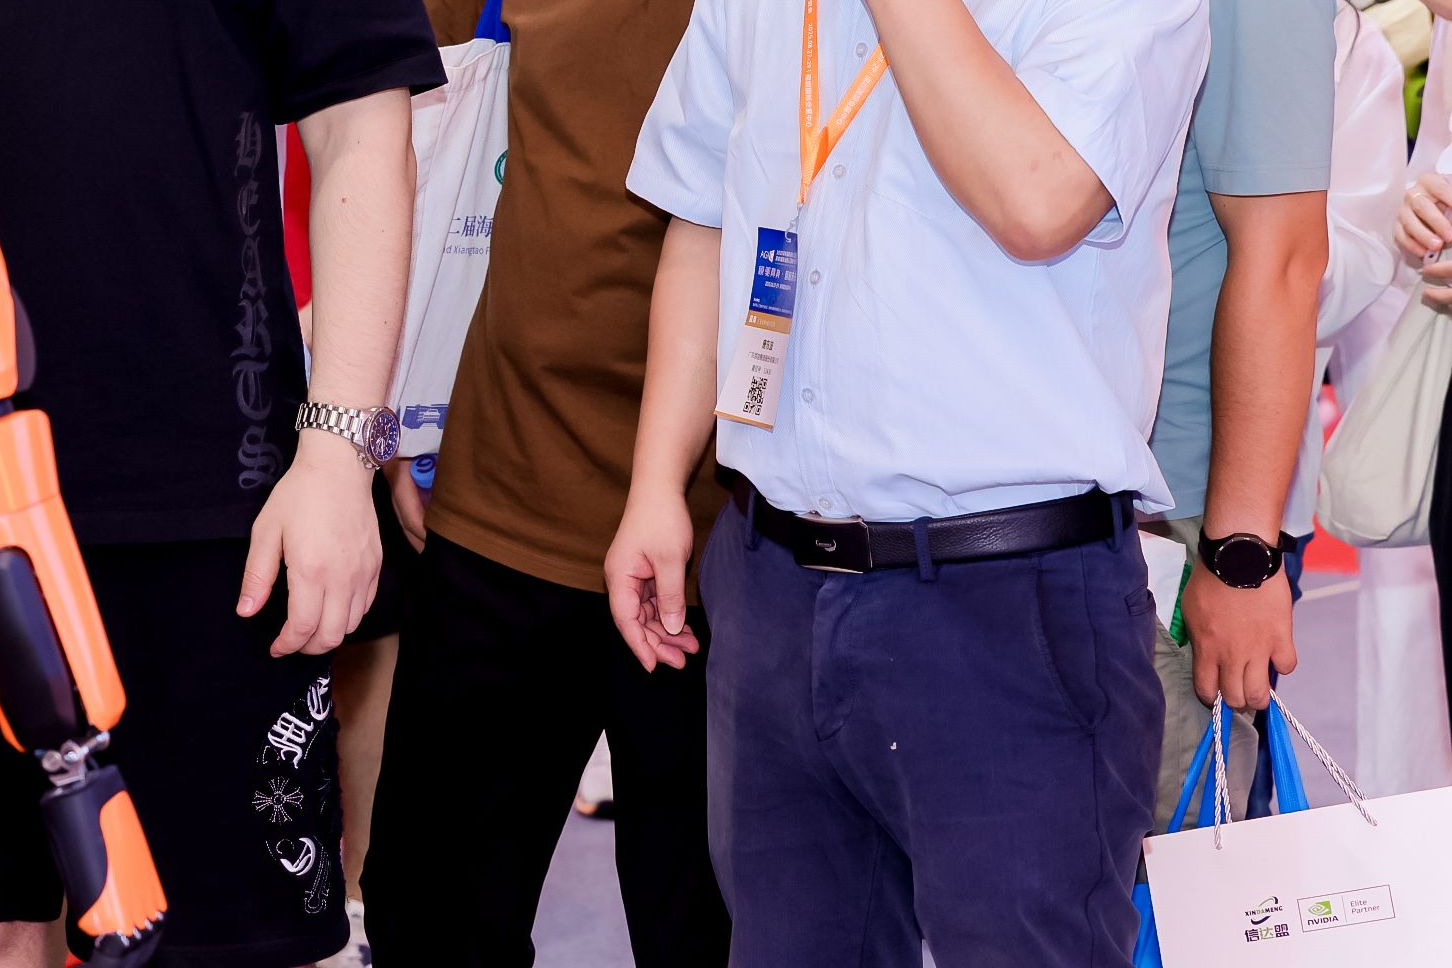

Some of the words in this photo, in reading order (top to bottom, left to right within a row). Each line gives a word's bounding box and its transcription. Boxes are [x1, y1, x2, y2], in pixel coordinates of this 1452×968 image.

[1350, 899, 1368, 908] Elite
[1351, 905, 1381, 915] Partner
[1307, 915, 1340, 926] NVIDIA
[1244, 923, 1290, 943] 信达盟
